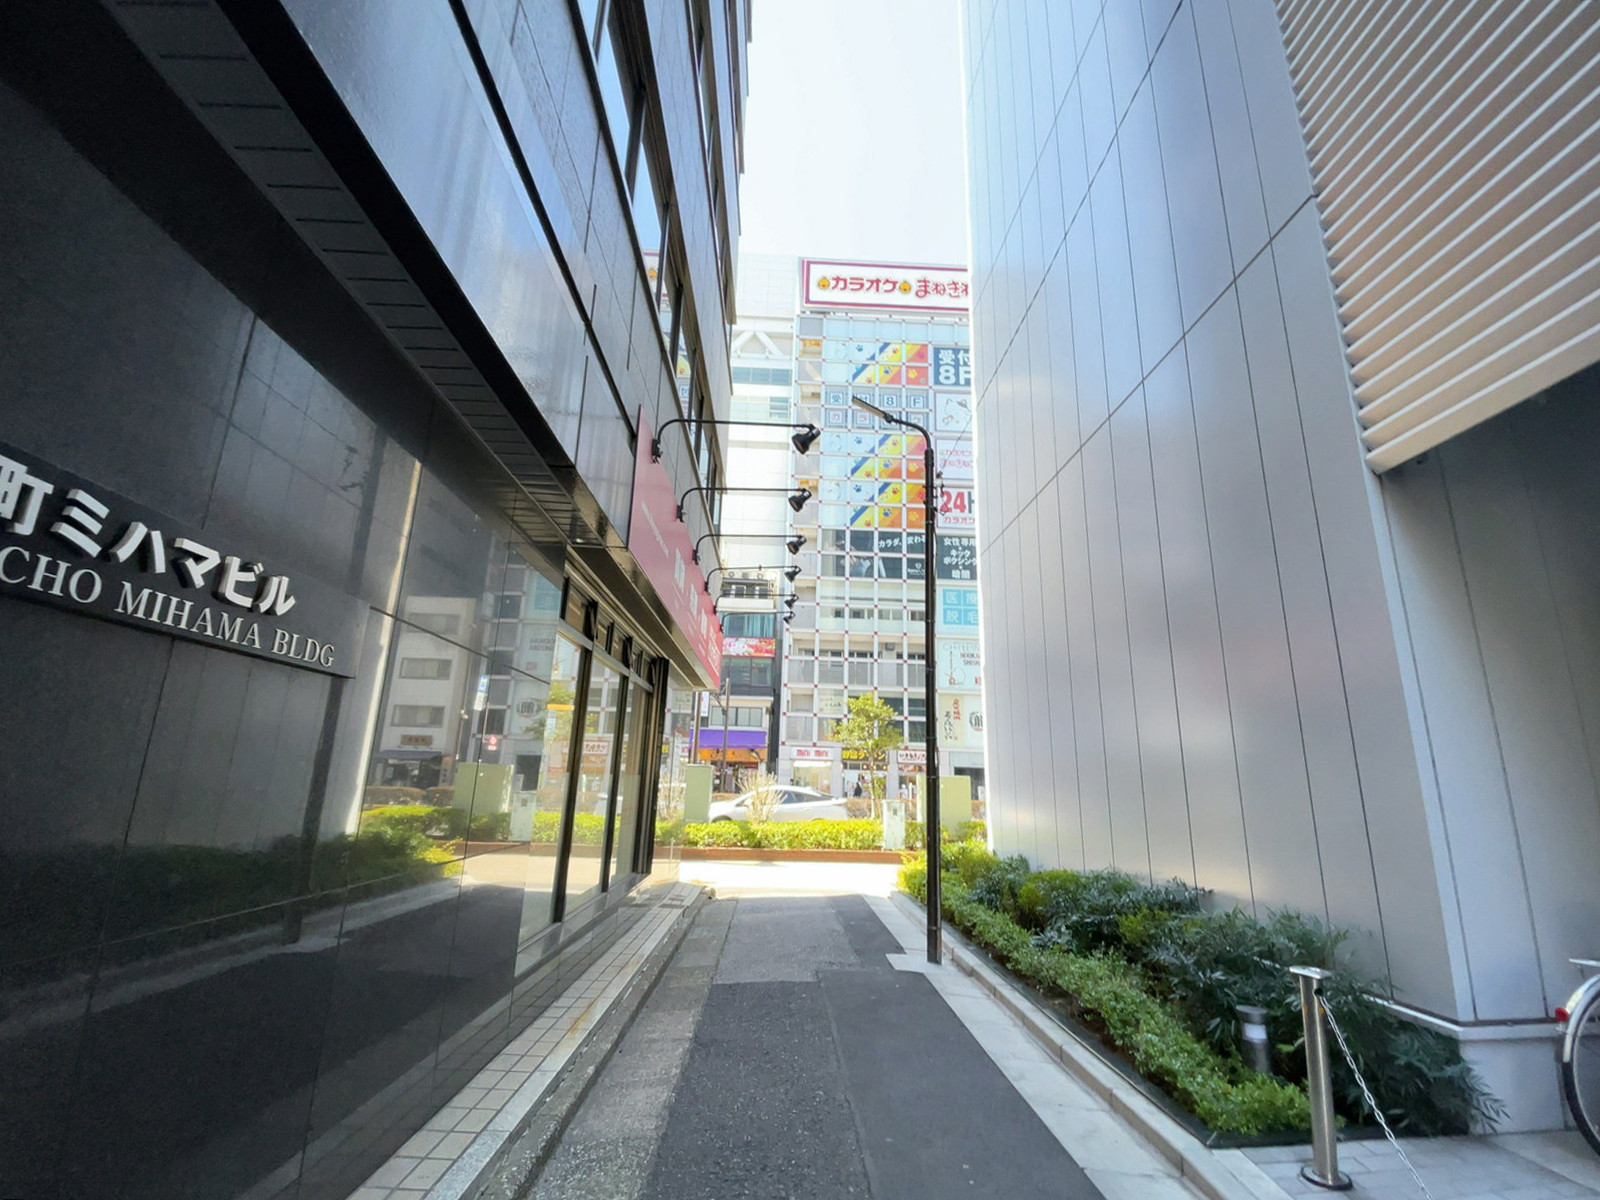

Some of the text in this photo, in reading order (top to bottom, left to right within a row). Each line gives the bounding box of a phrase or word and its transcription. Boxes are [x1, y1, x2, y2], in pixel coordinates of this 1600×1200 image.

[831, 275, 899, 294] カラオケ
[0, 453, 296, 617] 町ミハマビル
[113, 580, 262, 650] MIHAMA
[271, 627, 336, 669] BLDG
